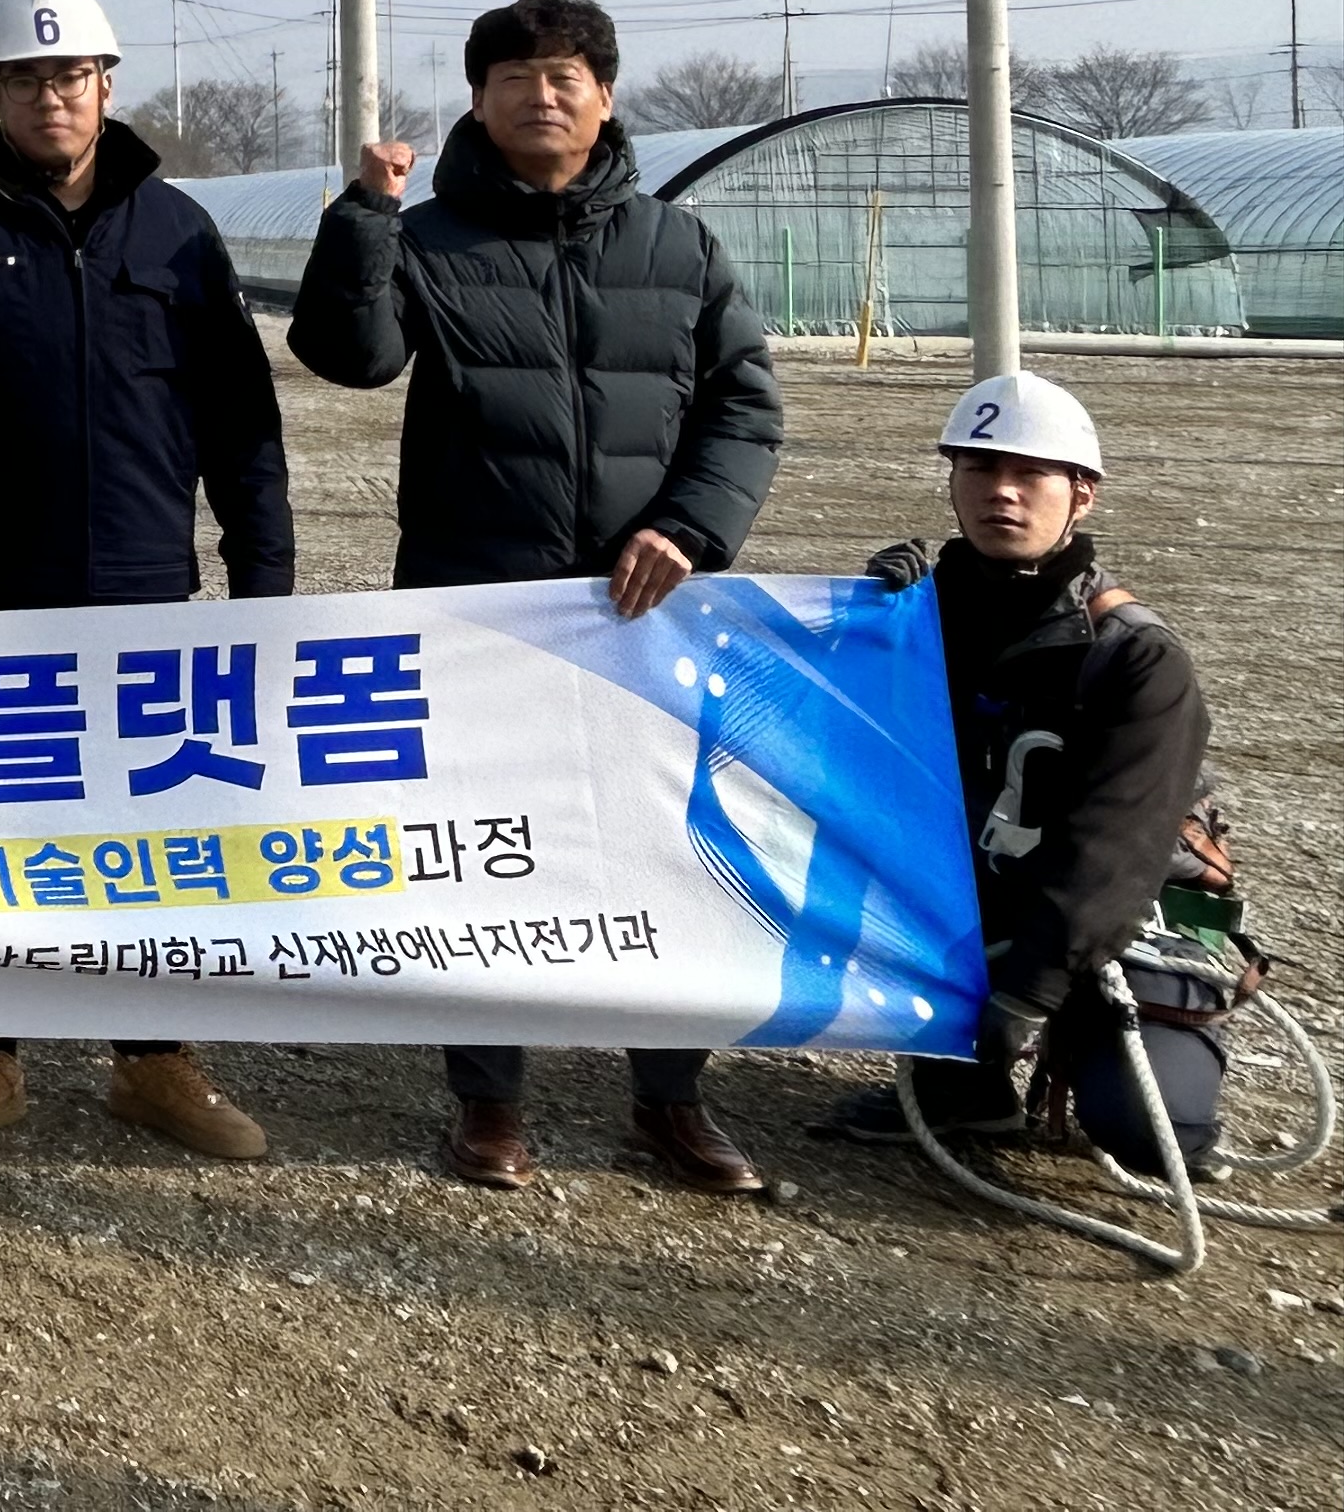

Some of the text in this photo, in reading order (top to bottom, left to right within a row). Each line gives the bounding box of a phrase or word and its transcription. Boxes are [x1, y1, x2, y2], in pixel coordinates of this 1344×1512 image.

[34, 7, 60, 46] 6
[969, 402, 1001, 440] 2
[259, 813, 535, 890] 양성과정
[268, 909, 659, 980] 신재생에너지전기과
